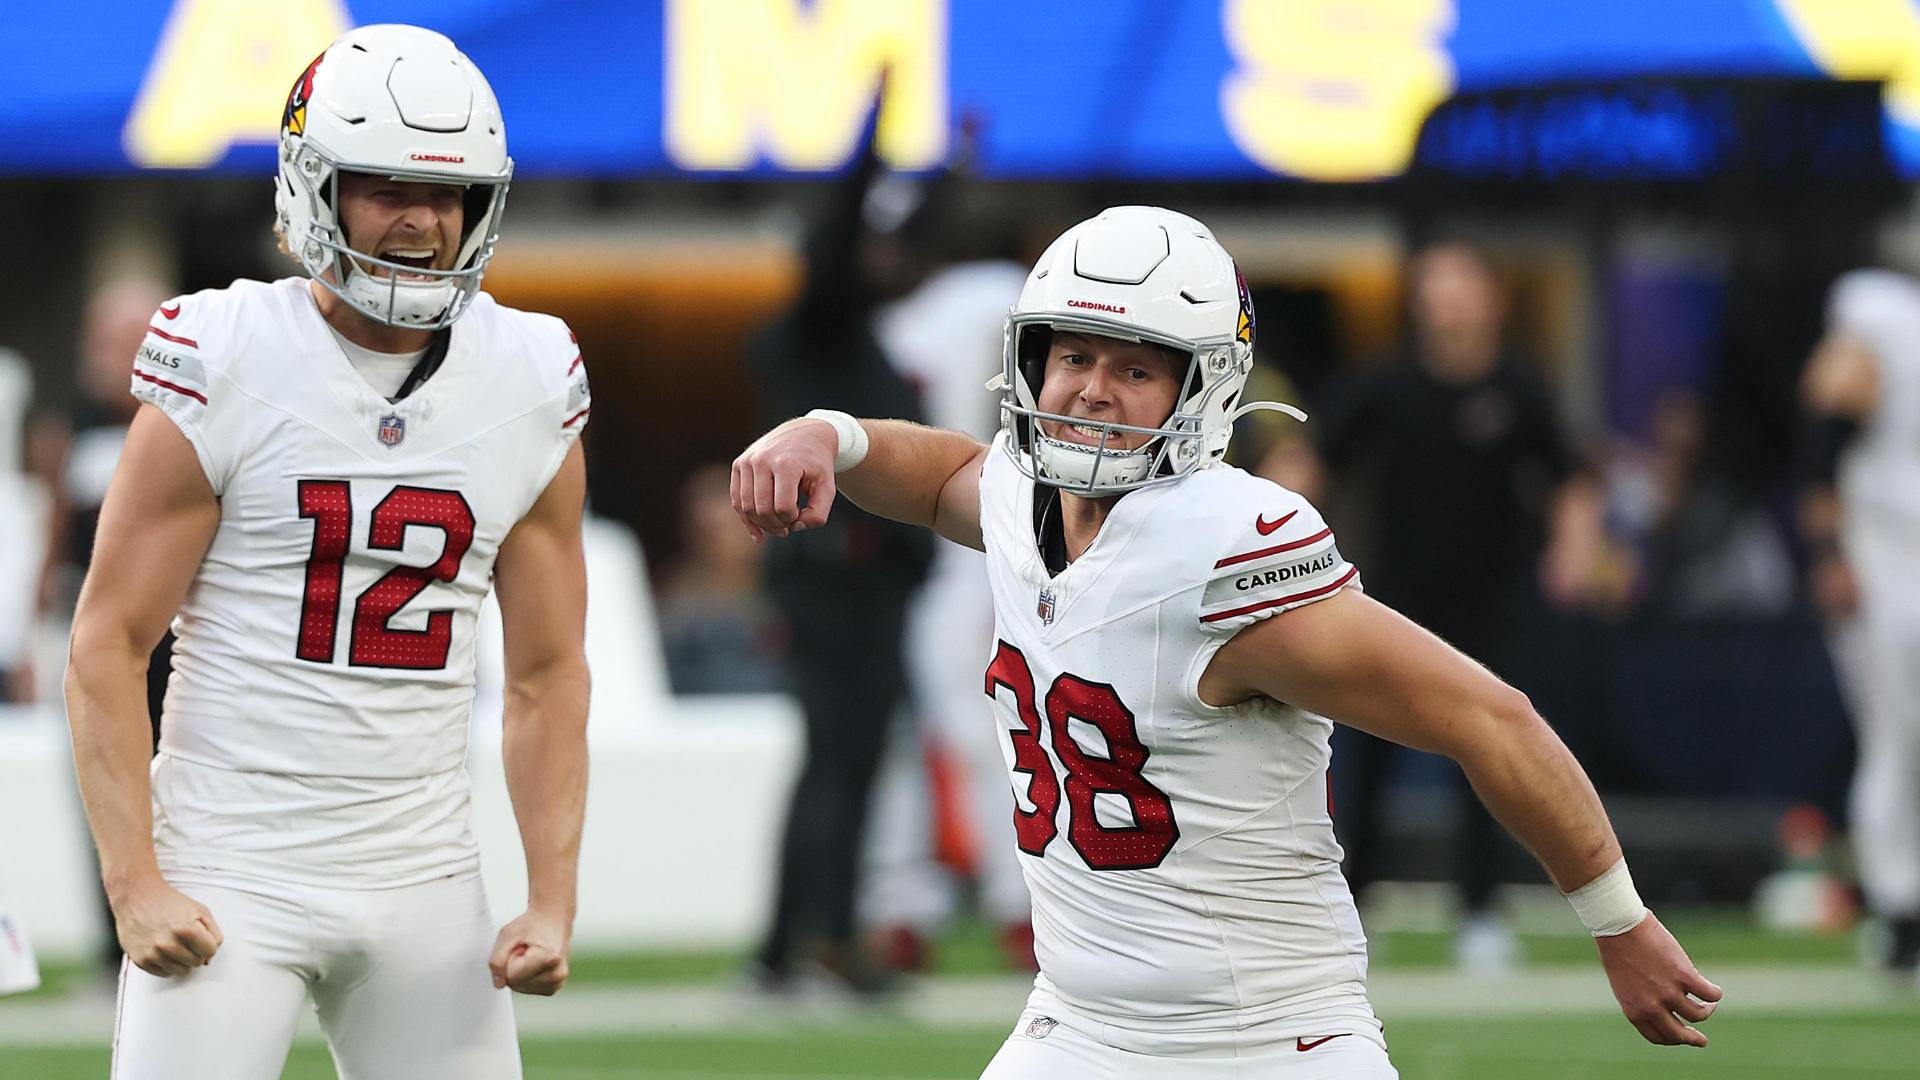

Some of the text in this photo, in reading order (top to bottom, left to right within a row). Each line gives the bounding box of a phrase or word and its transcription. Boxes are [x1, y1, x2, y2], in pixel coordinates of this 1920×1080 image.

[410, 153, 465, 163] CARDINALS
[1067, 300, 1126, 314] CARDINALS
[139, 346, 181, 369] INALS
[296, 479, 476, 670] 12
[1235, 553, 1334, 591] CARDINALS
[984, 638, 1181, 871] 38
